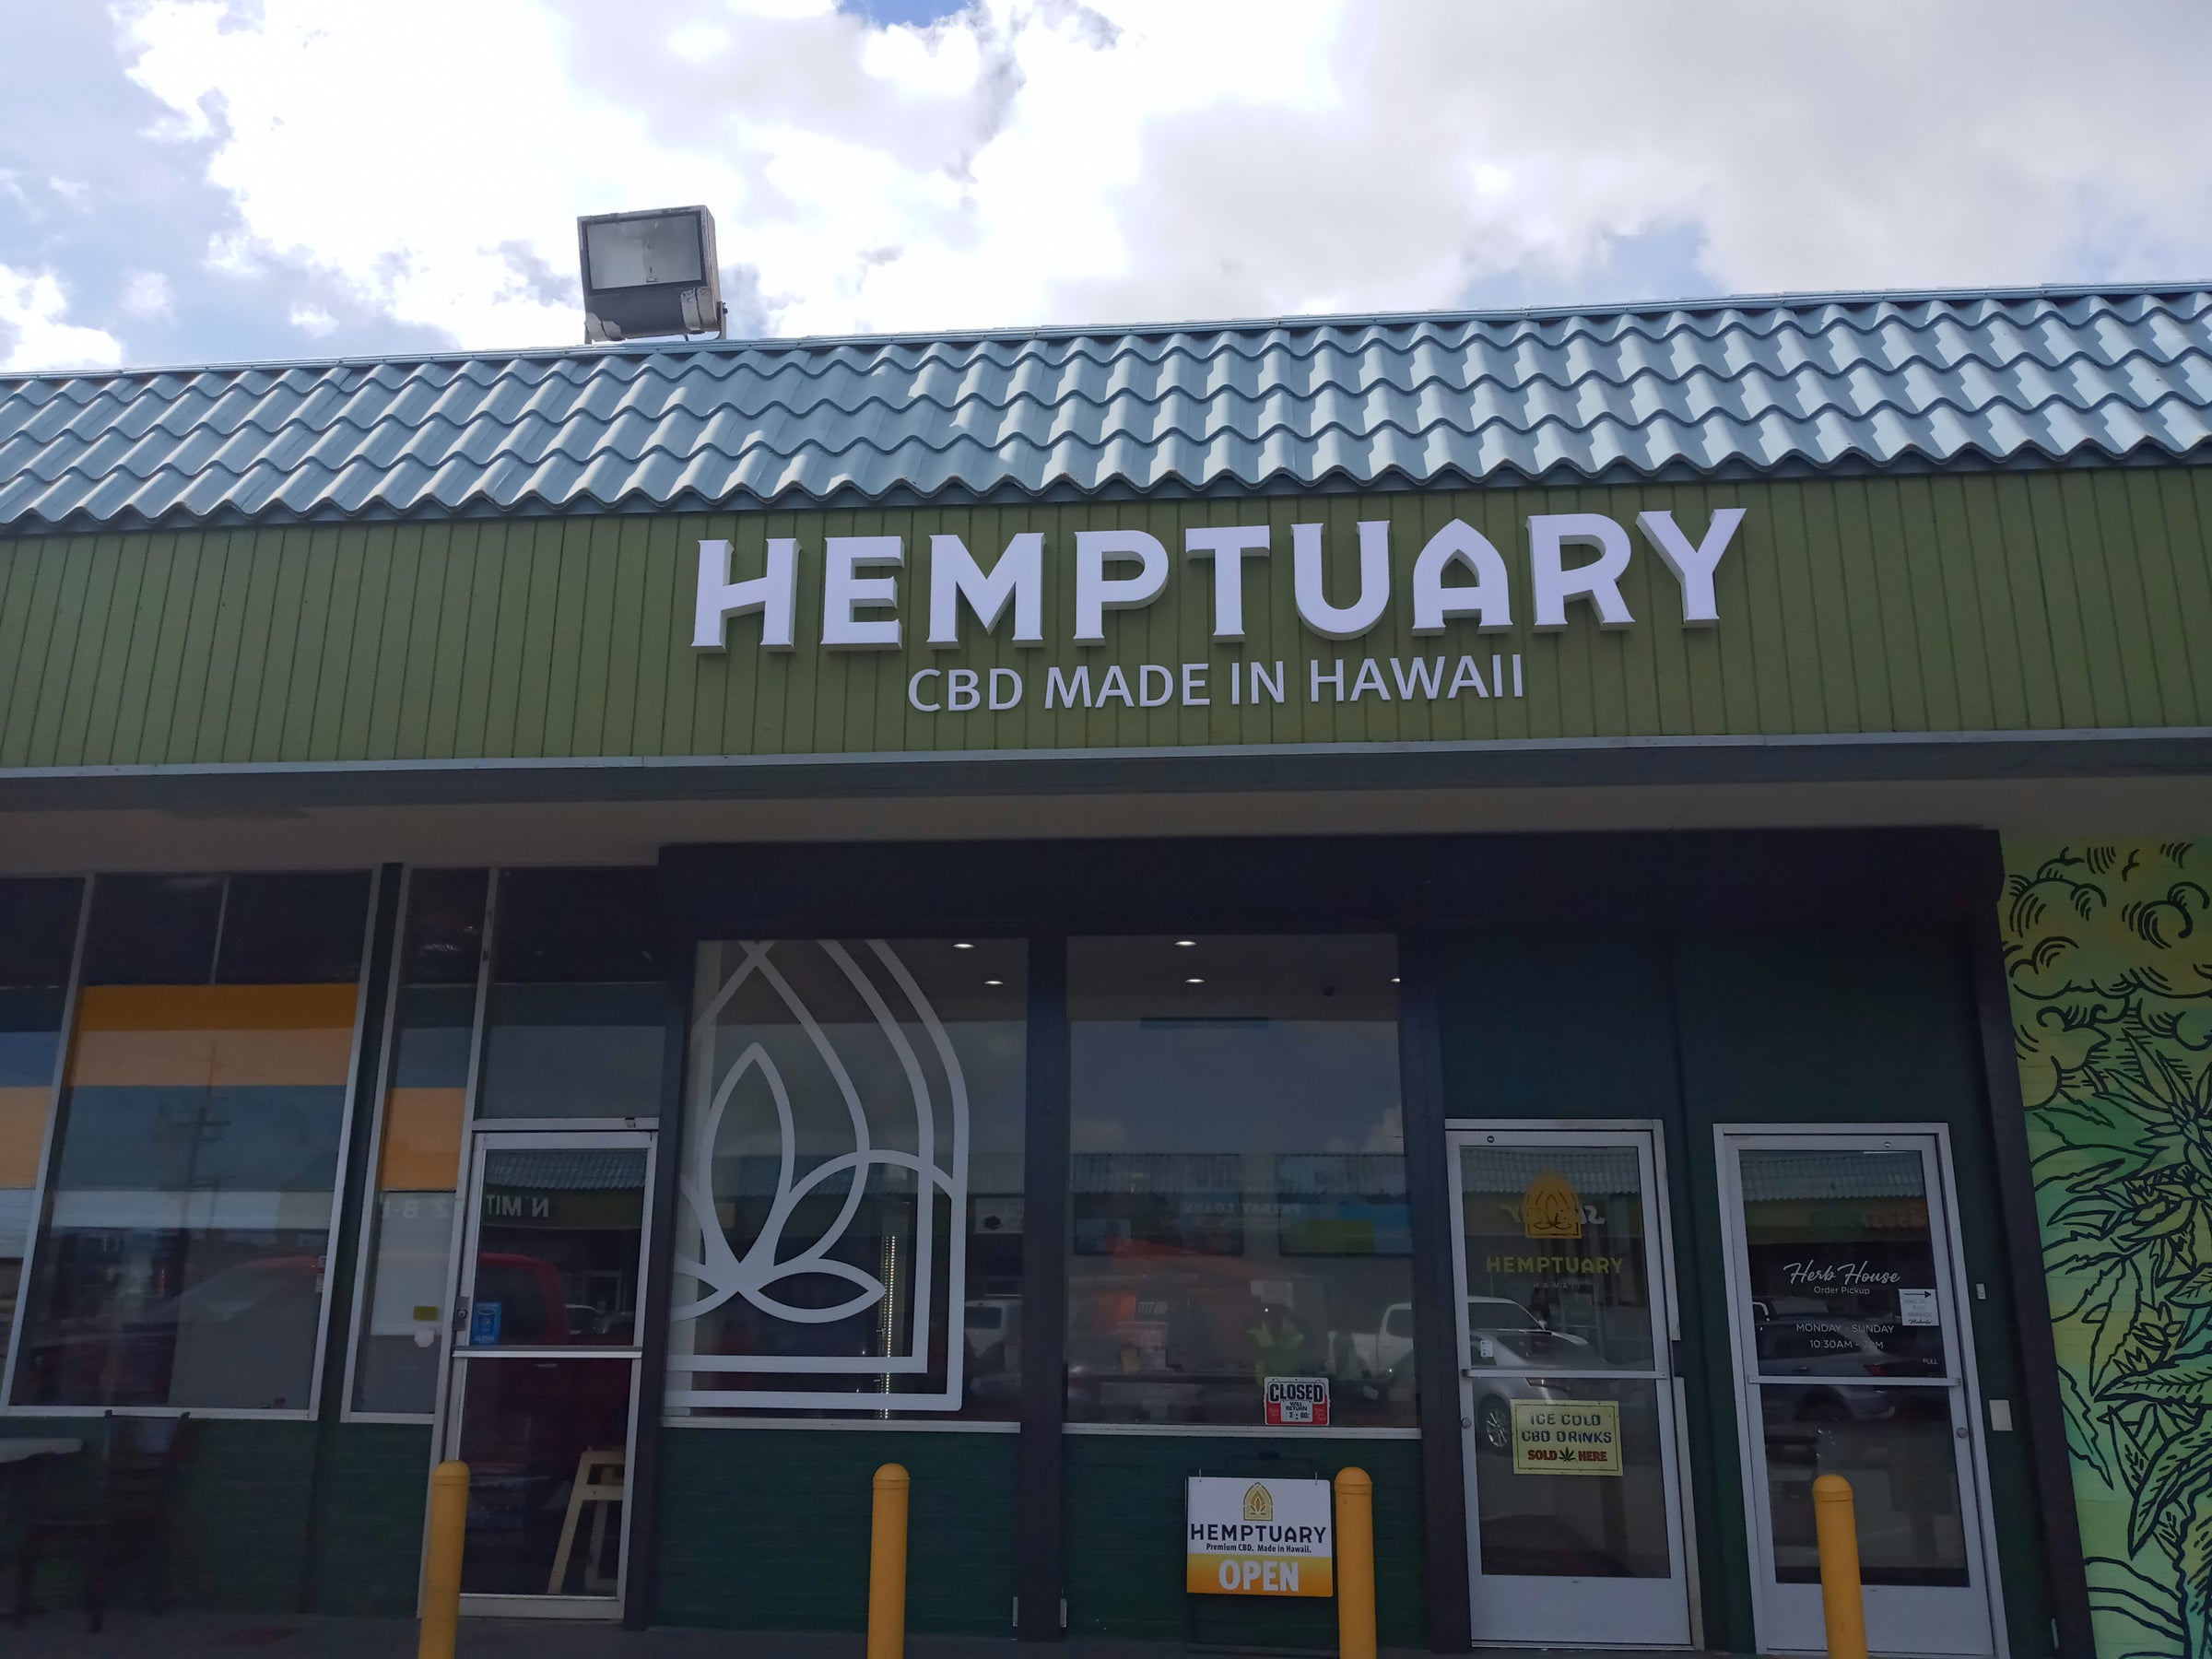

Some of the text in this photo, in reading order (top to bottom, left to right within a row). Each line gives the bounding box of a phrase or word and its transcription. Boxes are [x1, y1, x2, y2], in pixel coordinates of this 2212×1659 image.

[690, 508, 1747, 653] HEMPTUARY
[908, 654, 1524, 712] CBD MADE IN HAWAII
[1486, 1255, 1623, 1275] HEMPTUARY
[1783, 1259, 1900, 1286] Herb House
[1813, 1286, 1871, 1296] Order Pickup
[1796, 1323, 1842, 1333] MONDAY
[1852, 1324, 1895, 1334] SUNDAY
[1809, 1339, 1853, 1349] 10:30AM
[1269, 1383, 1324, 1403] CLOSED
[1530, 1413, 1602, 1427] ICE COLD
[1521, 1430, 1612, 1444] CBD DRINKS
[1527, 1449, 1608, 1463] SOLD HERE
[1190, 1524, 1327, 1544] HEMPTUARY
[1206, 1543, 1312, 1554] Premium CBD. Made in Hawaii.
[1218, 1559, 1300, 1593] OPEN
